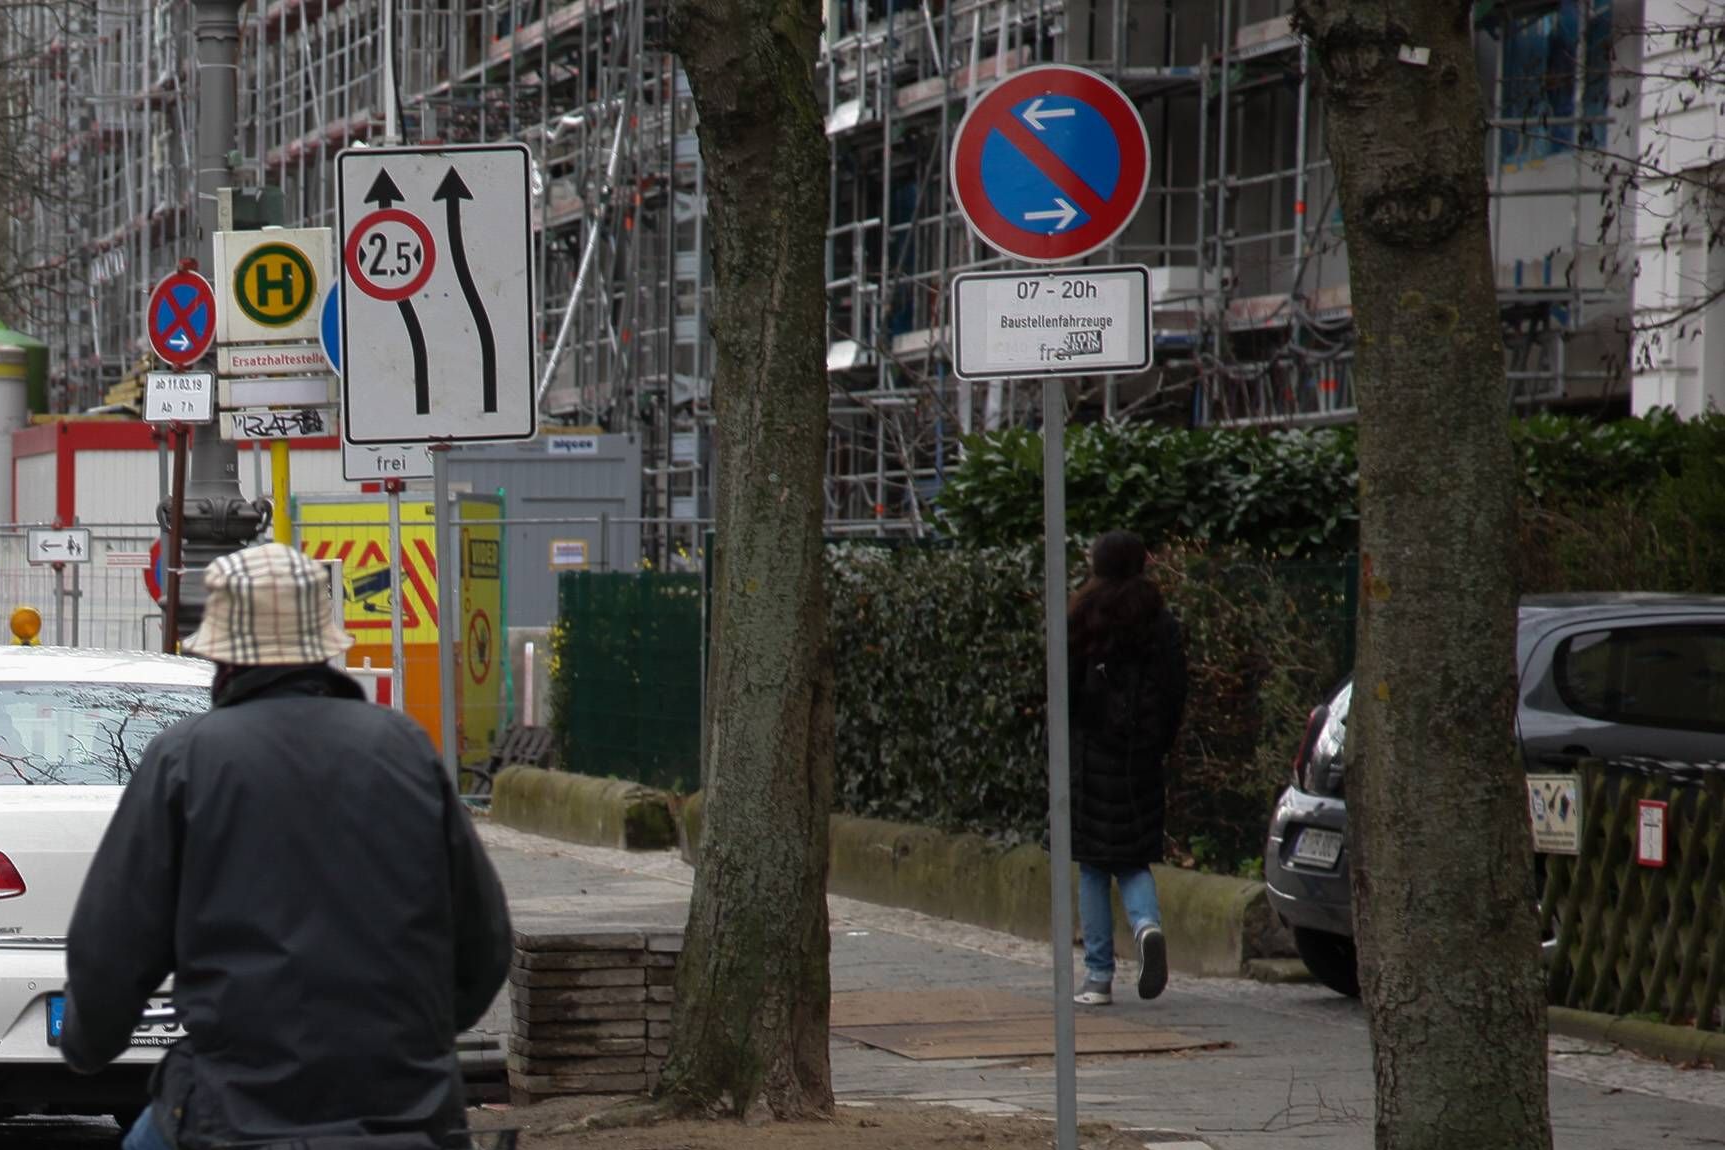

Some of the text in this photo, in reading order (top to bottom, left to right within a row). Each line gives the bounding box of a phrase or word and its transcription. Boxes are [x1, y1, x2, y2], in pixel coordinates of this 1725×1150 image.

[369, 232, 411, 278] 2,5
[256, 263, 293, 307] H
[1017, 281, 1040, 299] 07
[1061, 280, 1098, 299] 20h
[1000, 314, 1113, 331] Baustellenfahrzeuge
[232, 352, 325, 368] Ersatzhaltestelle
[377, 455, 406, 472] frei
